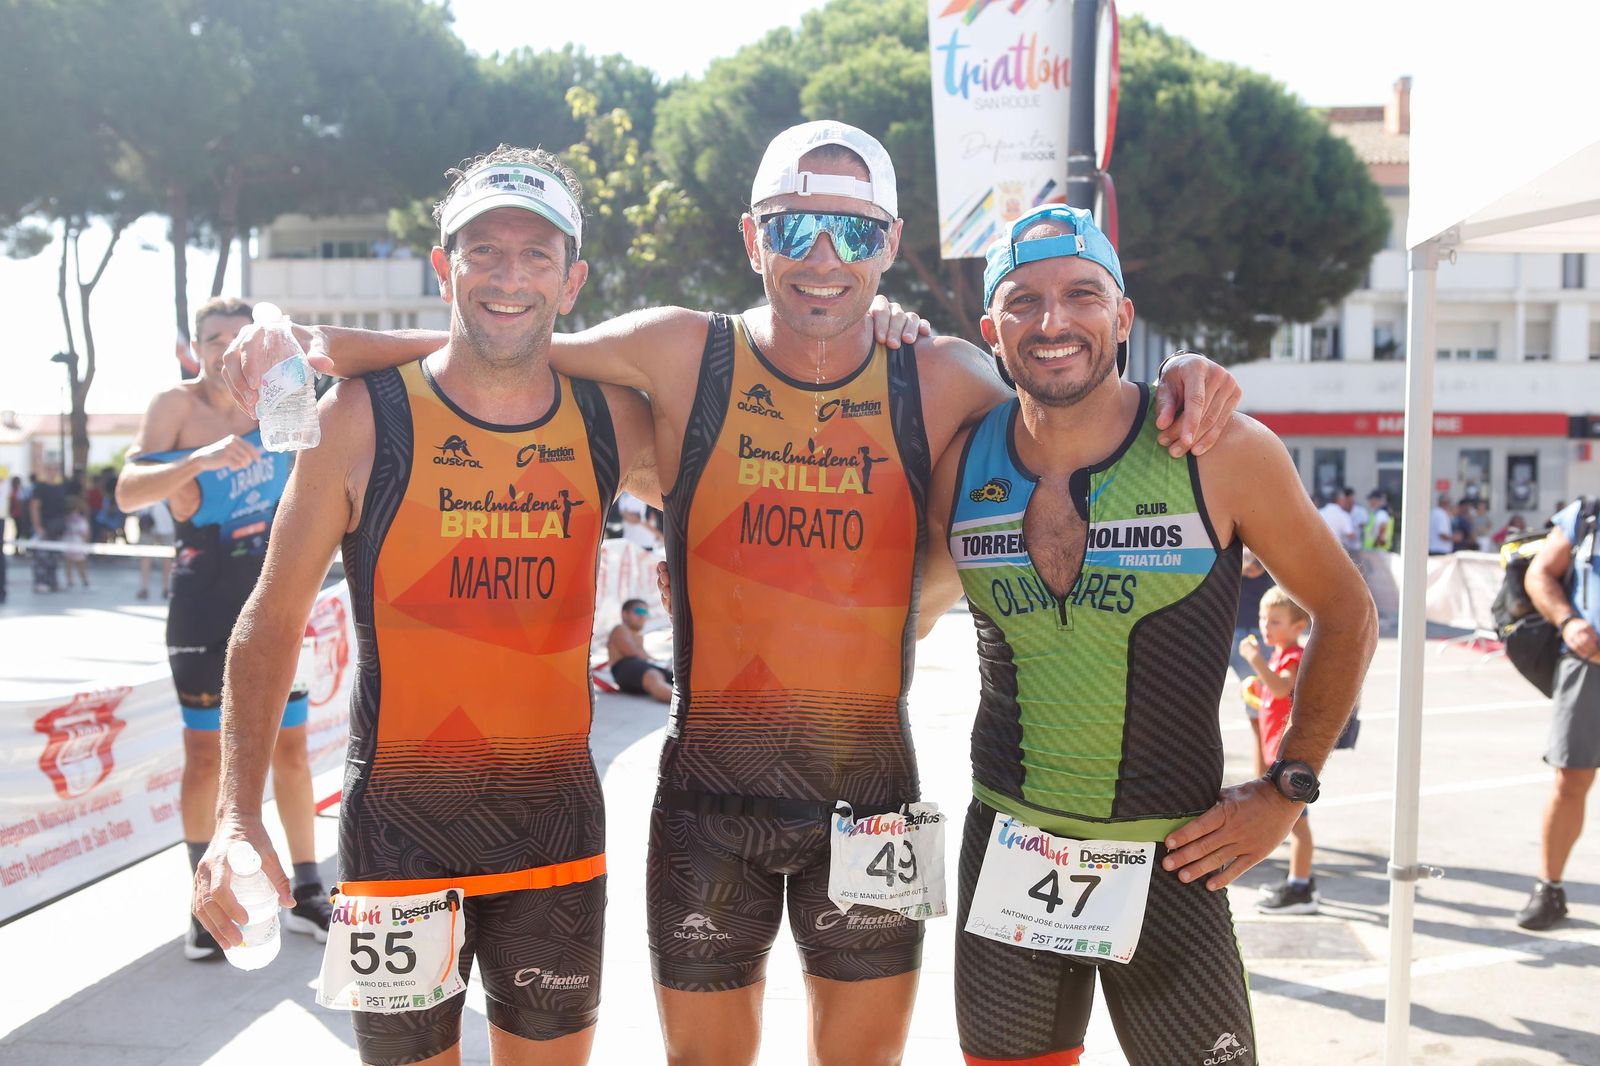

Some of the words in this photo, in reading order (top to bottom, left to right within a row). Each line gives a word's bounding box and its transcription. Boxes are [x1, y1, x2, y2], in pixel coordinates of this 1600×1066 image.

[936, 28, 1071, 100] triatlón
[974, 97, 1000, 110] SAN
[1001, 94, 1041, 109] ROQUE
[475, 172, 546, 191] ONMAN
[1377, 416, 1464, 432] MARE
[737, 459, 864, 494] BRILLA
[1135, 502, 1168, 516] CLUB
[440, 511, 564, 539] BRILLA
[739, 501, 864, 551] MORATO
[1118, 551, 1182, 567] TRIATLÓN
[449, 555, 555, 599] MARITO
[866, 840, 918, 888] 49
[859, 891, 889, 900] MANUEL
[1028, 869, 1102, 918] 47
[332, 900, 383, 926] atlón
[391, 899, 450, 922] Desafío
[1001, 908, 1034, 922] ANTONIO
[1054, 922, 1087, 931] OLIVARES
[673, 931, 733, 940] austral
[1030, 932, 1054, 945] PST
[350, 930, 417, 975] 55
[356, 980, 377, 988] MARIO
[393, 980, 416, 988] RIEGO
[366, 996, 386, 1007] PST
